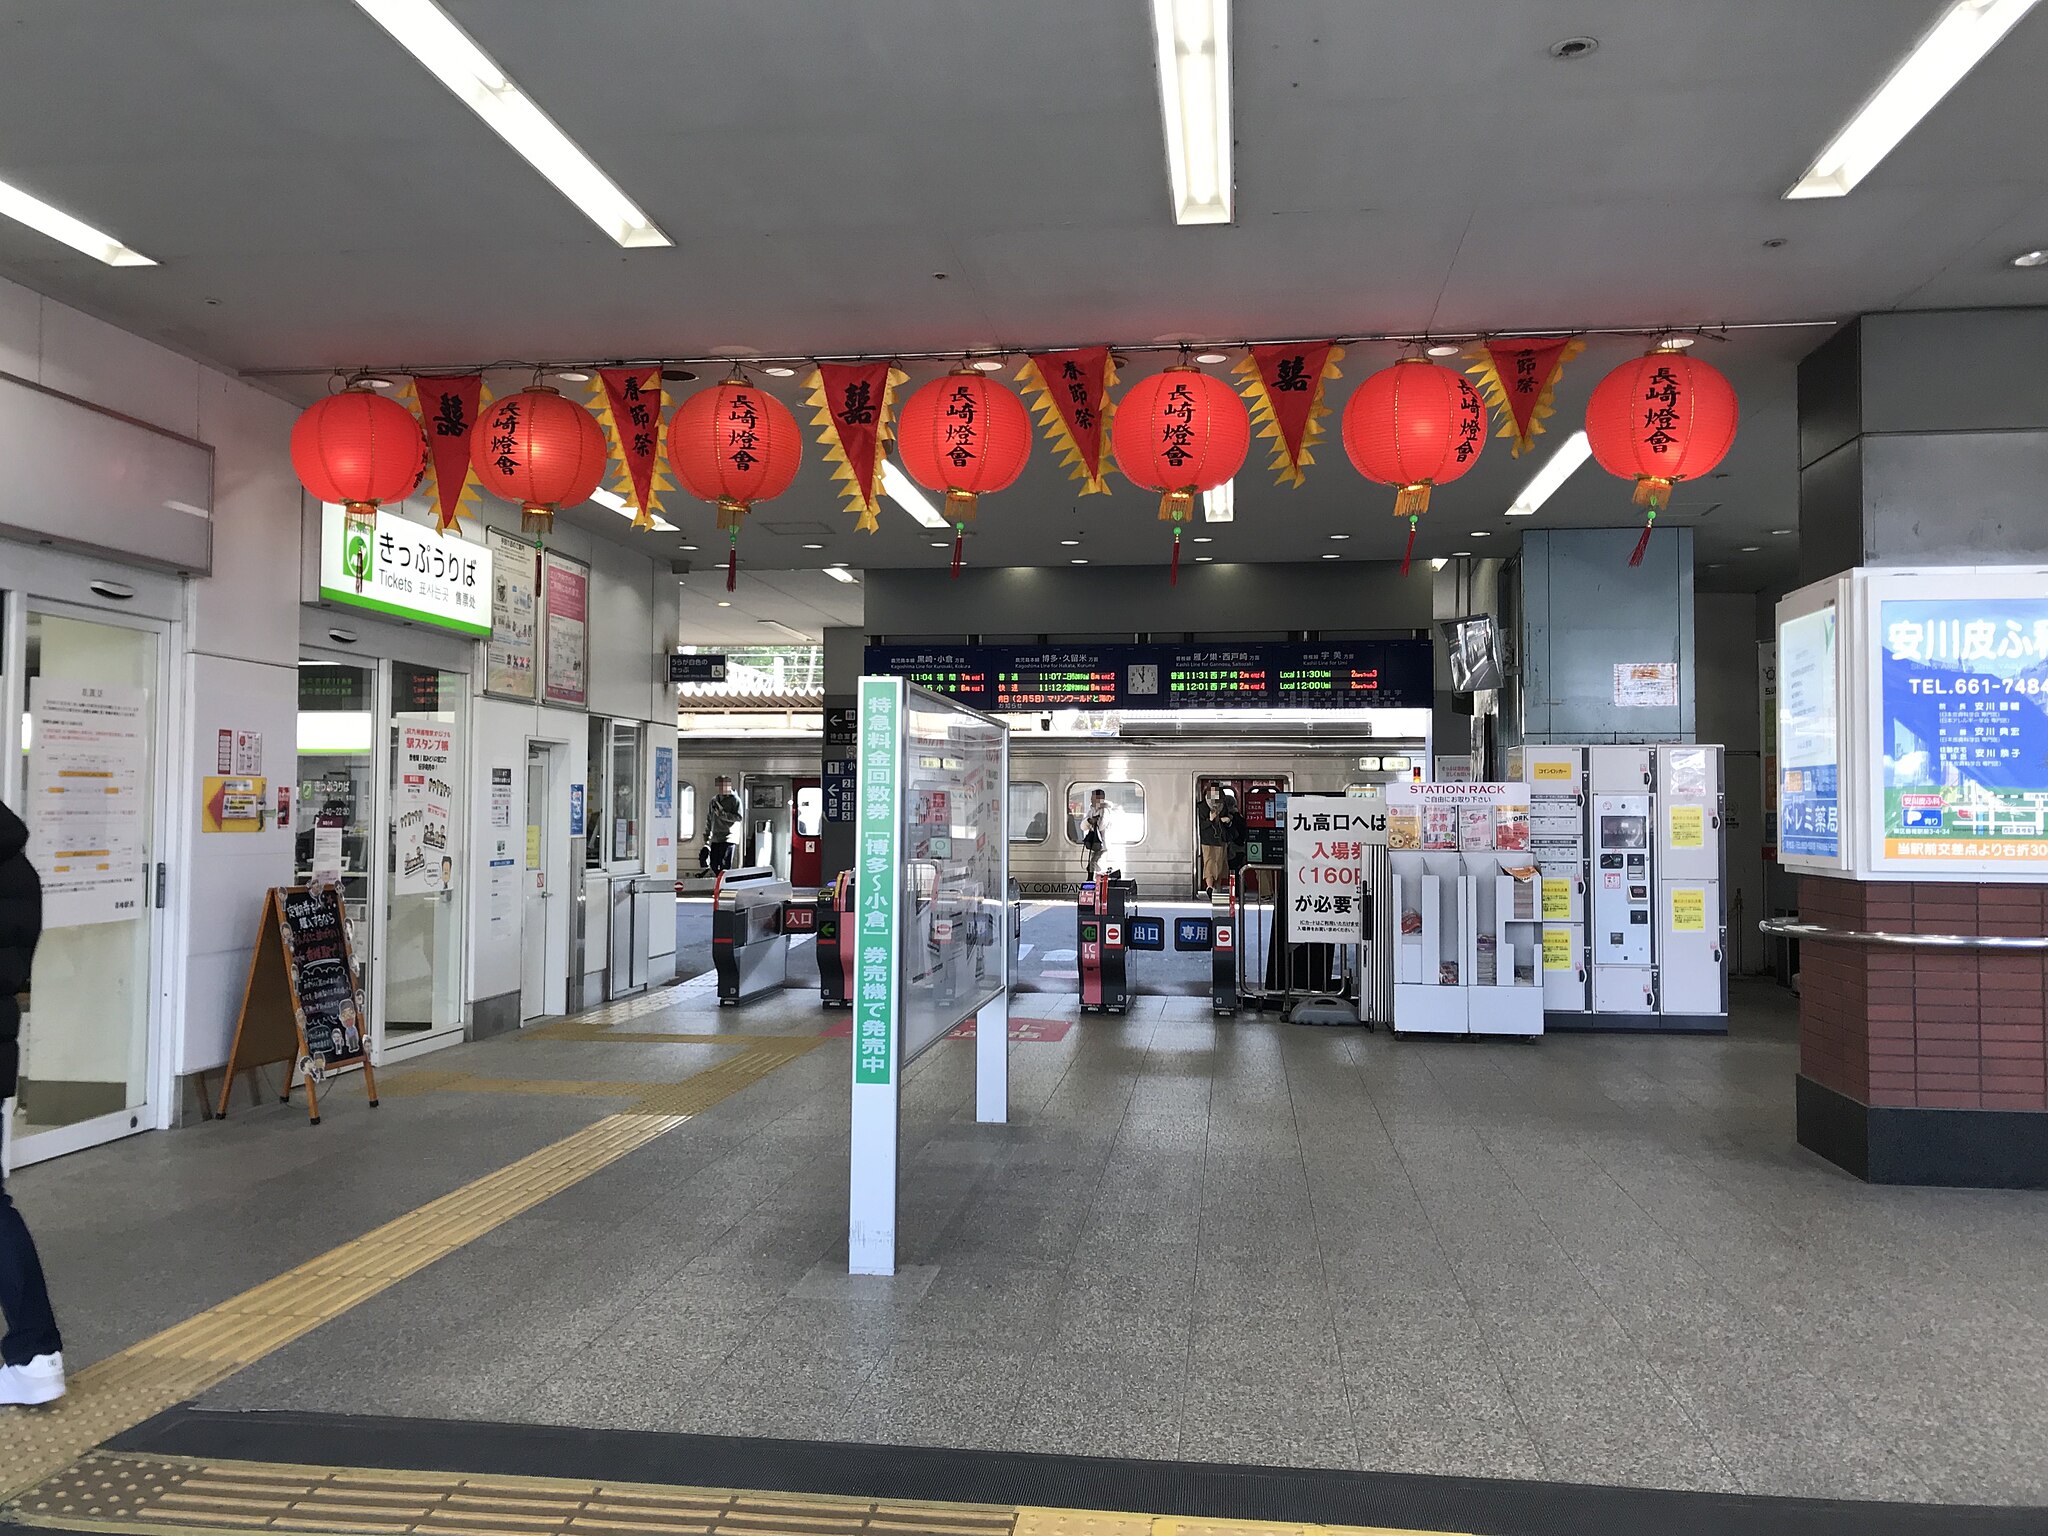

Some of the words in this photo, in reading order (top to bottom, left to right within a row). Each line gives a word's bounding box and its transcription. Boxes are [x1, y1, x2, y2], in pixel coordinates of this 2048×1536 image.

[1061, 359, 1096, 430] 春節祭
[1643, 366, 1681, 454] 長崎燈會
[945, 386, 978, 468] 長崎燈會
[1160, 384, 1196, 467] 長崎燈會
[490, 401, 521, 476] 長崎燈會
[728, 394, 760, 472] 長崎燈會
[379, 532, 478, 588] きっぷうりば
[378, 568, 413, 593] Tickets
[671, 658, 709, 666] うらが白色の
[1042, 654, 1087, 663] 博多・久留米
[910, 673, 933, 681] 11:04
[998, 673, 1019, 681] 普通
[1039, 673, 1062, 681] 11:07
[1170, 671, 1185, 680] 普通
[1186, 672, 1209, 680] 11:31
[1210, 672, 1238, 680] 西戸崎
[1279, 670, 1295, 679] Local
[1296, 670, 1321, 678] 11:30
[936, 684, 956, 692] 小倉
[998, 683, 1019, 692] 快速
[1039, 683, 1062, 692] 11:12
[1170, 682, 1185, 691] 普通
[1186, 683, 1209, 691] 12:01
[1210, 683, 1238, 691] 西戸崎
[1279, 681, 1295, 690] Local
[1296, 681, 1321, 690] 12:00
[1908, 678, 2048, 695] TEL.661-7484
[1974, 702, 1995, 711] 安川
[1974, 727, 1995, 736] 安川
[866, 696, 892, 821] 特急料金回数券
[1975, 748, 1996, 758] 安川
[1410, 785, 1468, 794] STATION
[1469, 785, 1506, 794] RACK
[1424, 796, 1492, 804] ご自由にお取り下さい
[1292, 812, 1386, 832] 九高口へは
[1783, 805, 1838, 834] ドレミ薬局
[1906, 811, 1923, 826] P
[1923, 817, 1939, 826] 有り
[1897, 842, 2048, 856] 当駅前交差点より右折30
[786, 912, 812, 925] 入口
[1133, 925, 1160, 941] 出口
[1180, 925, 1208, 941] 専用
[1084, 943, 1096, 953] IC
[861, 947, 888, 1075] 券売機で発売中
